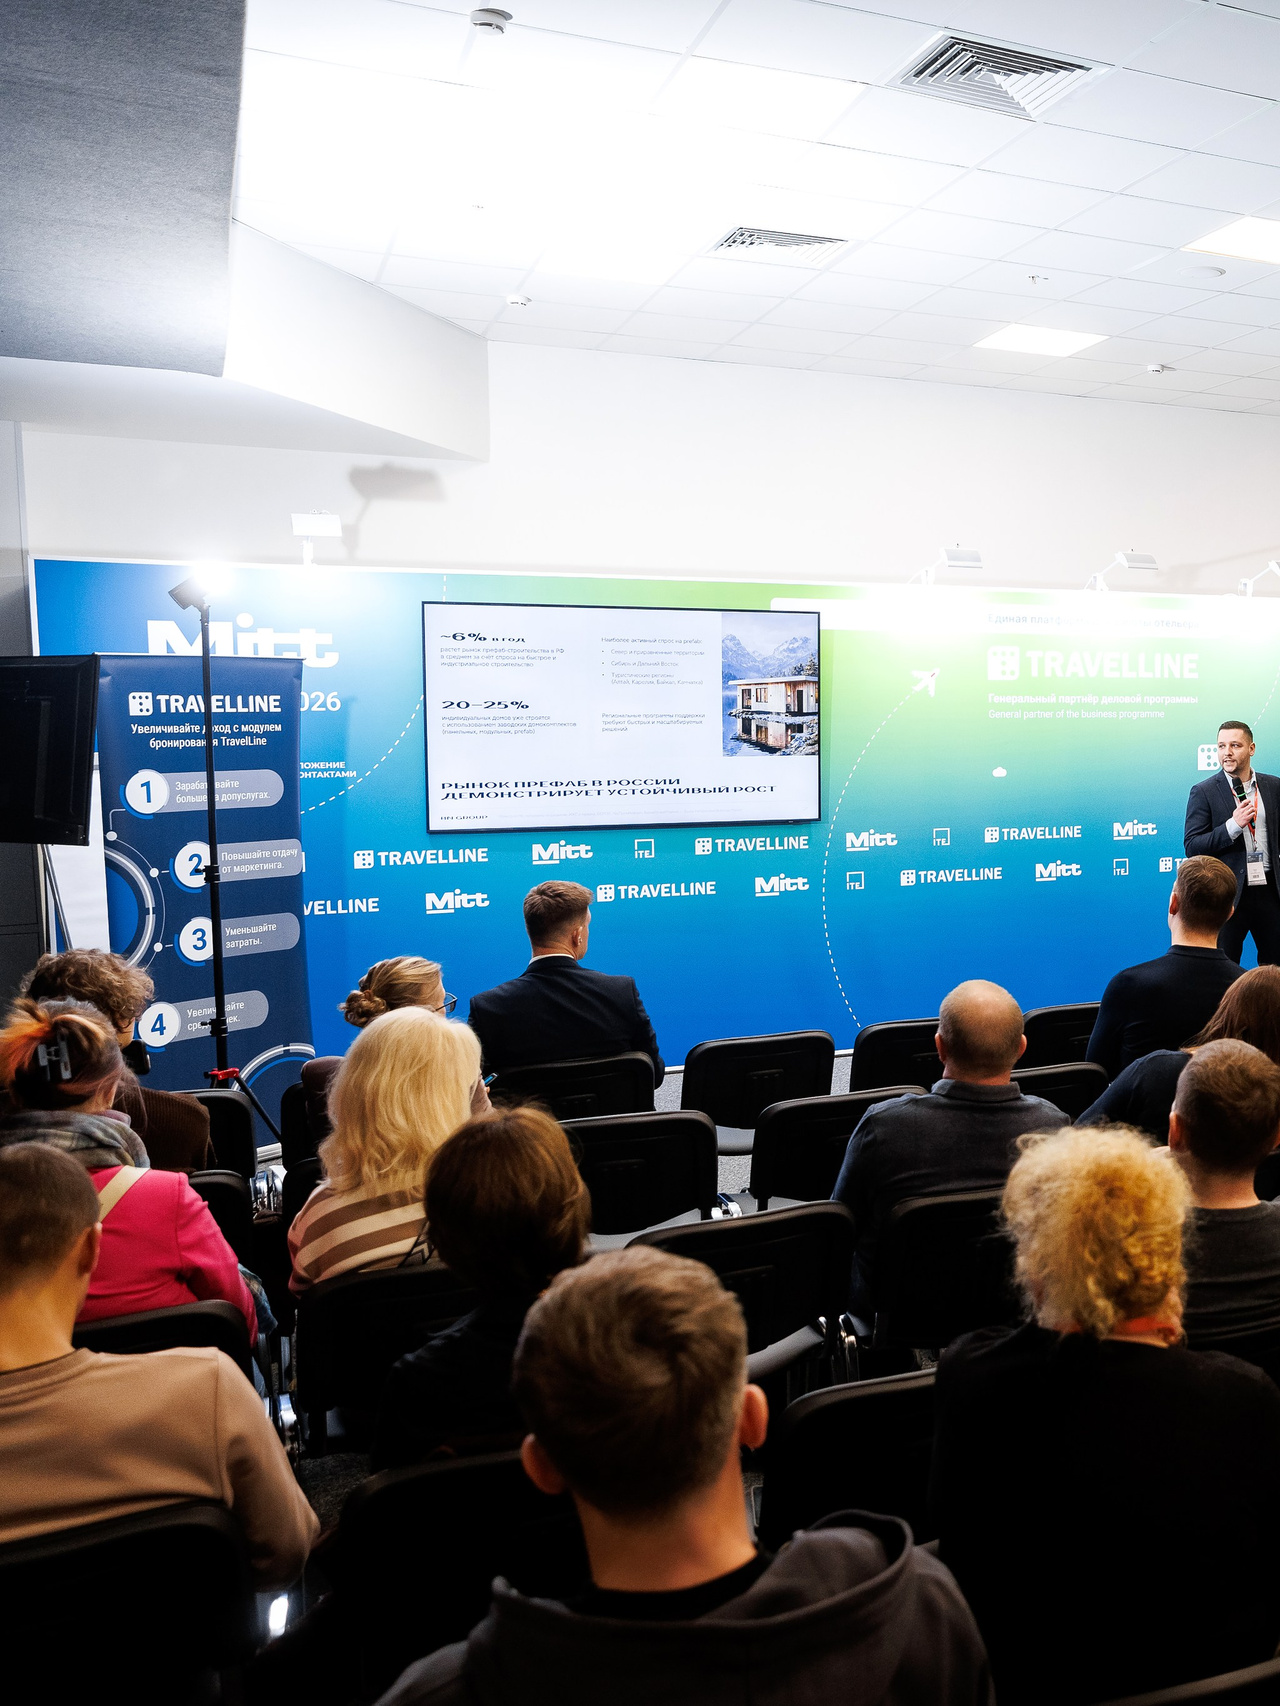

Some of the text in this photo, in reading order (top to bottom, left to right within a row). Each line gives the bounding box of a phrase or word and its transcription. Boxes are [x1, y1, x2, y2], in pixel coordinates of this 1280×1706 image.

[440, 632, 487, 642] ~6%
[1025, 649, 1199, 679] TRAVELLINE
[156, 695, 282, 714] TRAVELLINE
[988, 692, 1198, 706] Генеральный партнёр деловой программы
[988, 708, 1165, 720] General partner of the business programme
[130, 723, 200, 734] Увеличивайте
[241, 724, 282, 735] модулем
[150, 736, 267, 750] бронированя TravelLine
[140, 780, 152, 804] 1
[176, 780, 240, 791] Зарабатвайте
[441, 782, 510, 790] РЫНОК
[514, 780, 588, 788] ПРЕФАБ
[607, 778, 680, 786] РОССИИ
[441, 785, 776, 800] ДЕМОНСТРИРУЕТ УСТОЙЧИВЫЙ РОСТ
[176, 794, 209, 804] больше
[224, 792, 270, 804] допуслугах.
[1002, 825, 1082, 840] TRAVELLINE
[1114, 819, 1158, 836] Mitt
[715, 836, 809, 852] TRAVELLINE
[846, 829, 898, 848] Mitt
[222, 848, 298, 861] Повышайте отдачу
[377, 848, 488, 866] TRAVELLINE
[532, 840, 593, 860] Mitt
[188, 853, 204, 876] 2
[222, 862, 284, 874] от маркетинга.
[1036, 860, 1082, 878] Mitt
[755, 873, 810, 893] Mitt
[918, 867, 1002, 884] TRAVELLINE
[426, 888, 490, 910] Mitt
[618, 882, 716, 900] TRAVELLINE
[225, 922, 277, 936] Уменьшайте
[192, 928, 206, 950] 3
[226, 938, 262, 949] затраты.
[187, 1001, 244, 1018] Увеличайте
[150, 1013, 166, 1036] 4
